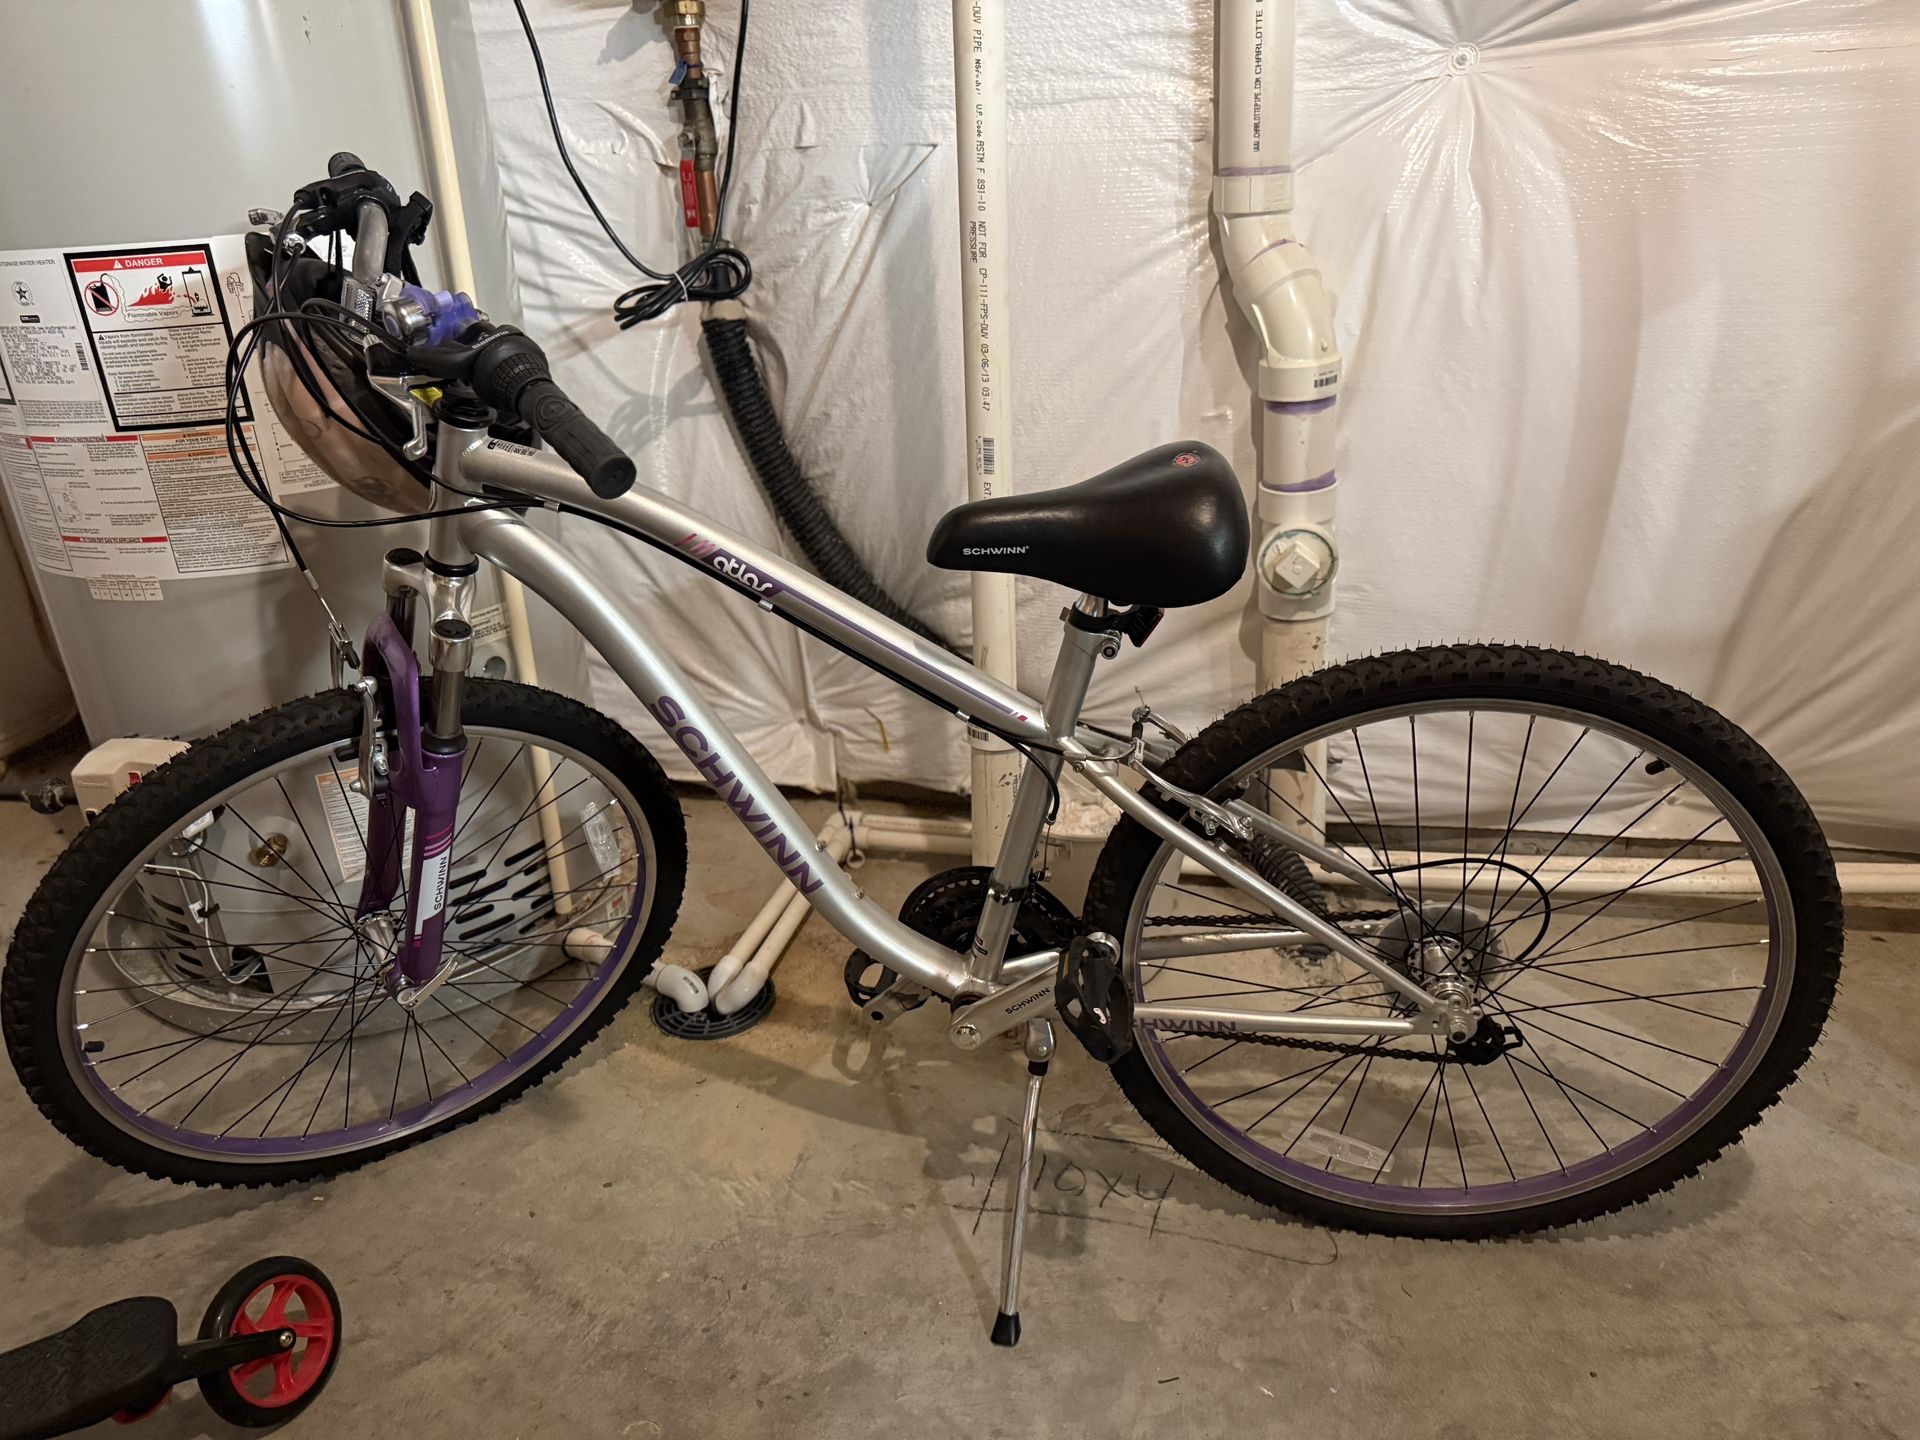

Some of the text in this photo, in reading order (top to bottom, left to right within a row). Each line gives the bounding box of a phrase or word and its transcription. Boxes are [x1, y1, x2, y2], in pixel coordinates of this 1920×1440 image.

[973, 29, 983, 53] PIPE
[1255, 9, 1263, 75] CHARLOTTE
[976, 140, 985, 163] ASTM
[977, 178, 986, 212] 891-10
[969, 221, 978, 264] PRESSURE
[978, 221, 987, 237] NOT
[125, 257, 164, 268] DANGER
[978, 242, 987, 259] FOR
[980, 343, 990, 383] 03/06/13
[713, 556, 773, 592] atlas
[650, 695, 824, 895] SCHWINN
[434, 856, 448, 911] SCHWINN
[1005, 987, 1051, 1014] SCHWINN
[1132, 1018, 1236, 1033] HWINN
